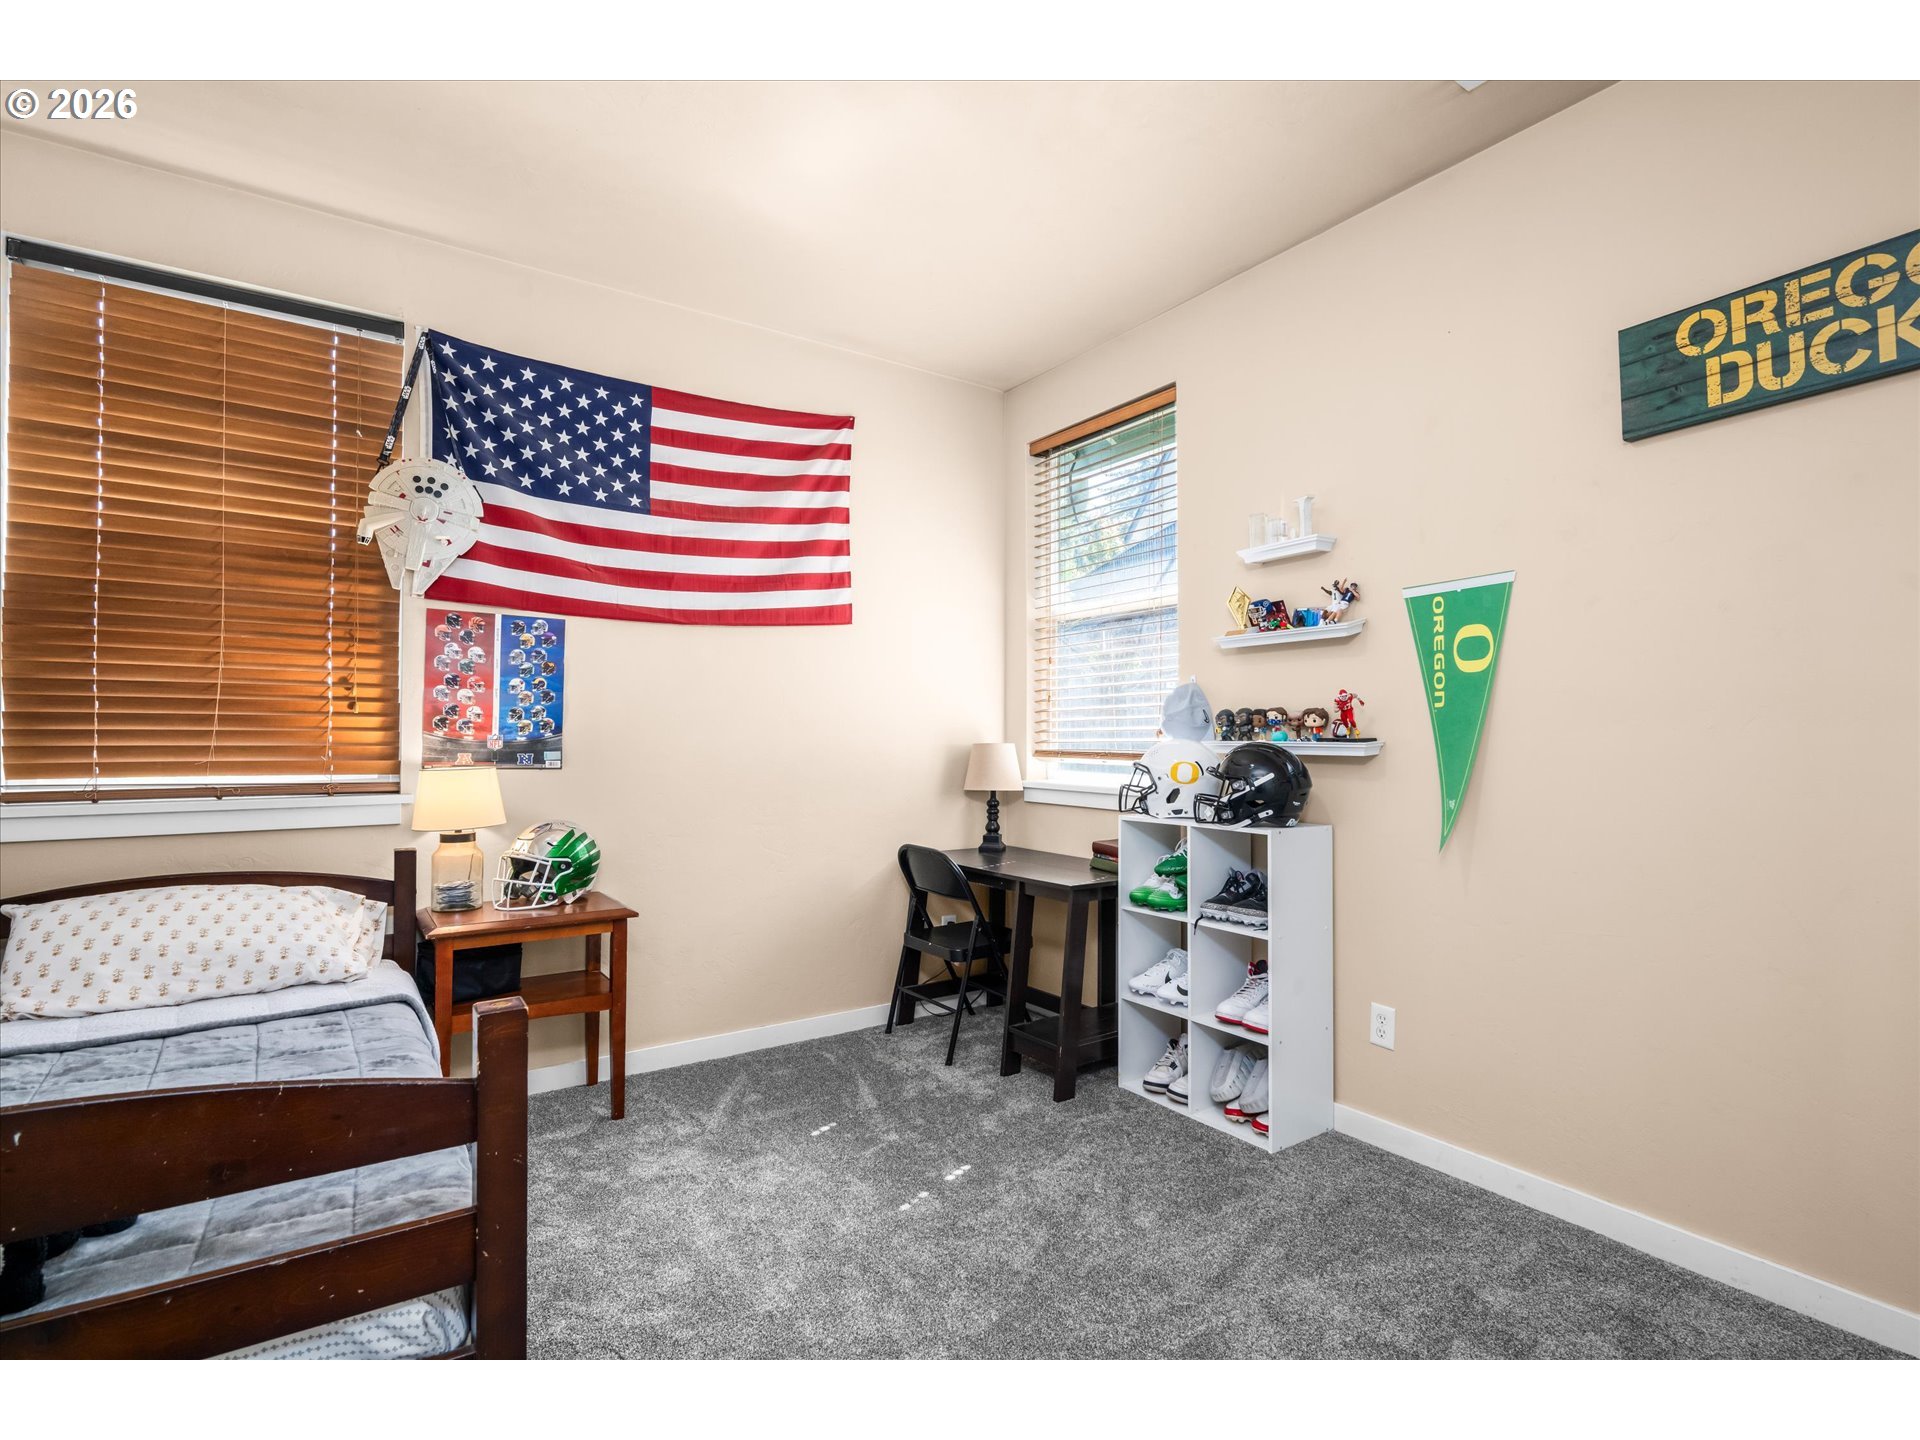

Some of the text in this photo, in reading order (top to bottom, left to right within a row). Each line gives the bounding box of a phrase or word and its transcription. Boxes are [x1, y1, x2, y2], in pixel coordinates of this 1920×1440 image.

[1675, 241, 1920, 357] OREG
[1453, 623, 1494, 673] O
[1170, 761, 1199, 785] O
